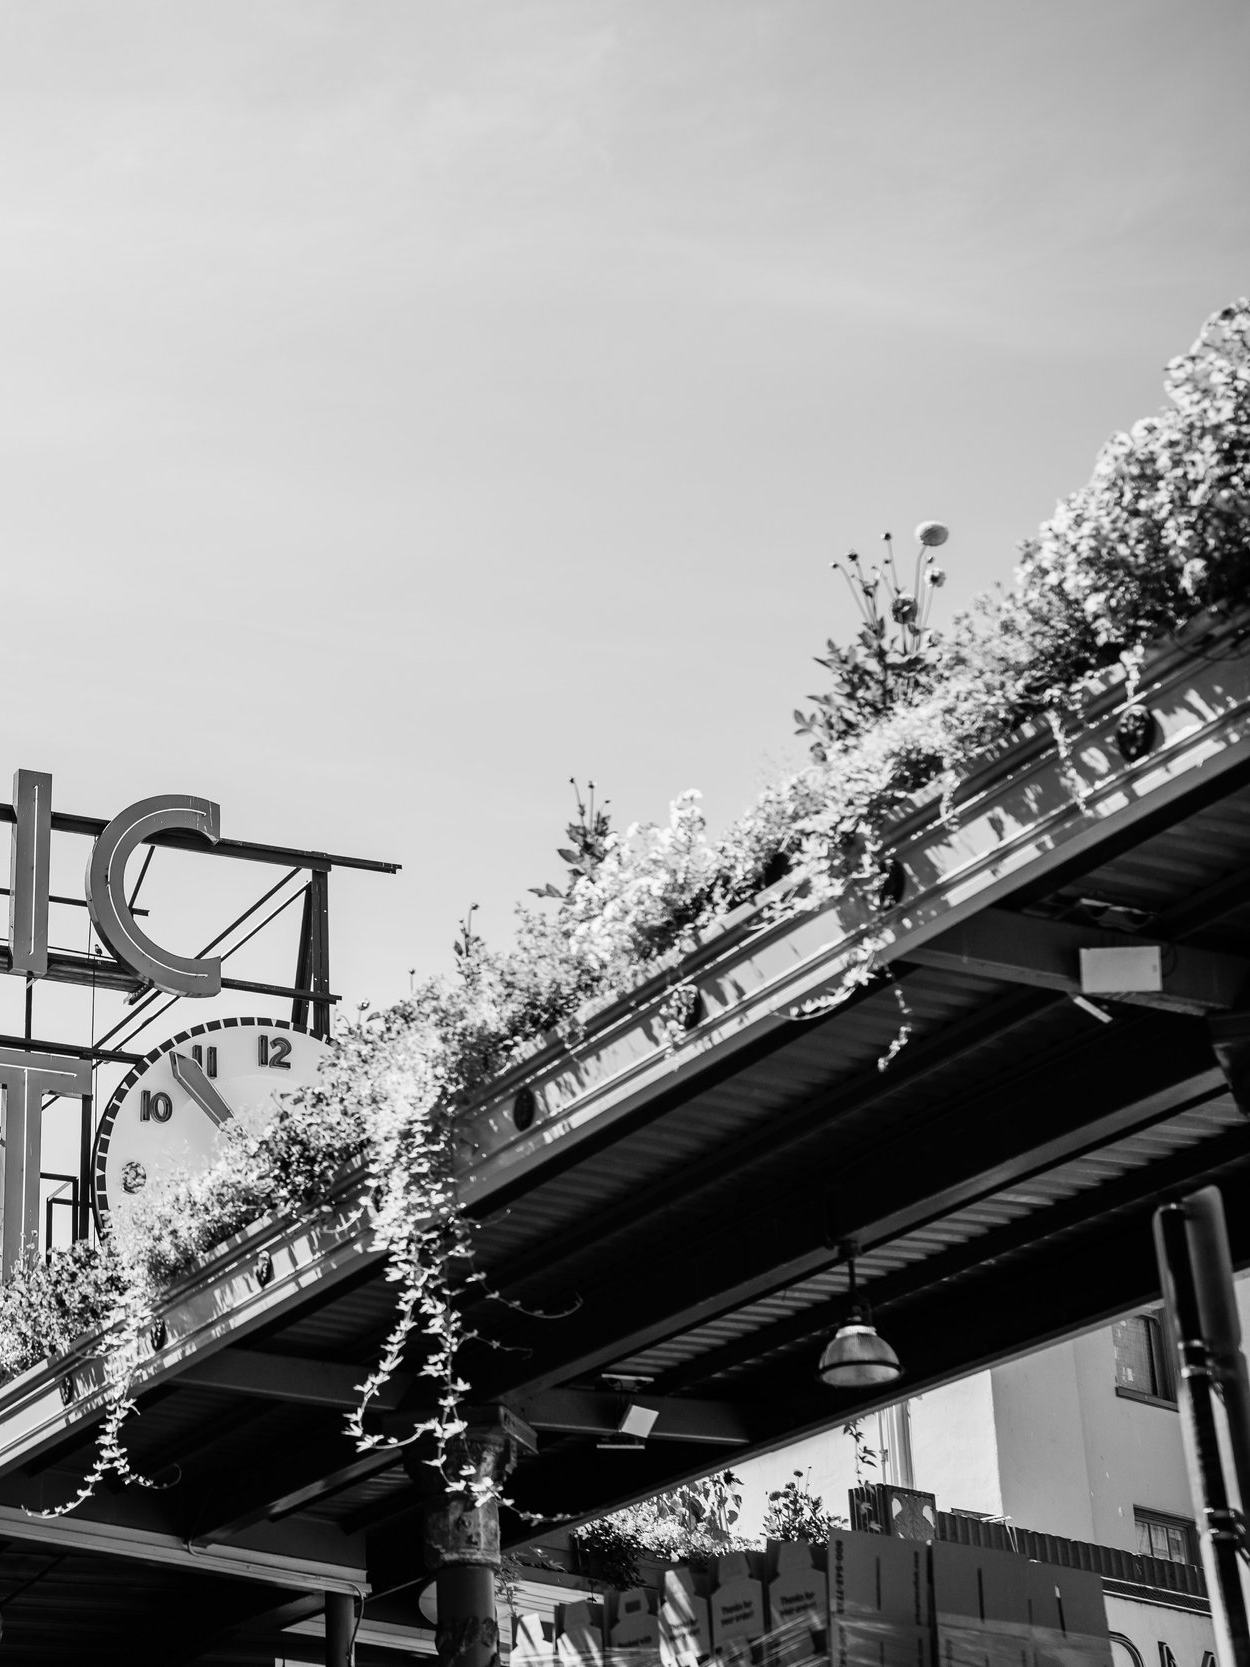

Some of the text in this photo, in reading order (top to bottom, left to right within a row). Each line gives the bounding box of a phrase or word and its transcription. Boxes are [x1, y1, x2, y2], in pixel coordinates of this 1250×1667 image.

[258, 1034, 292, 1070] 12
[140, 1089, 173, 1123] 10
[721, 1603, 744, 1615] Thanks
